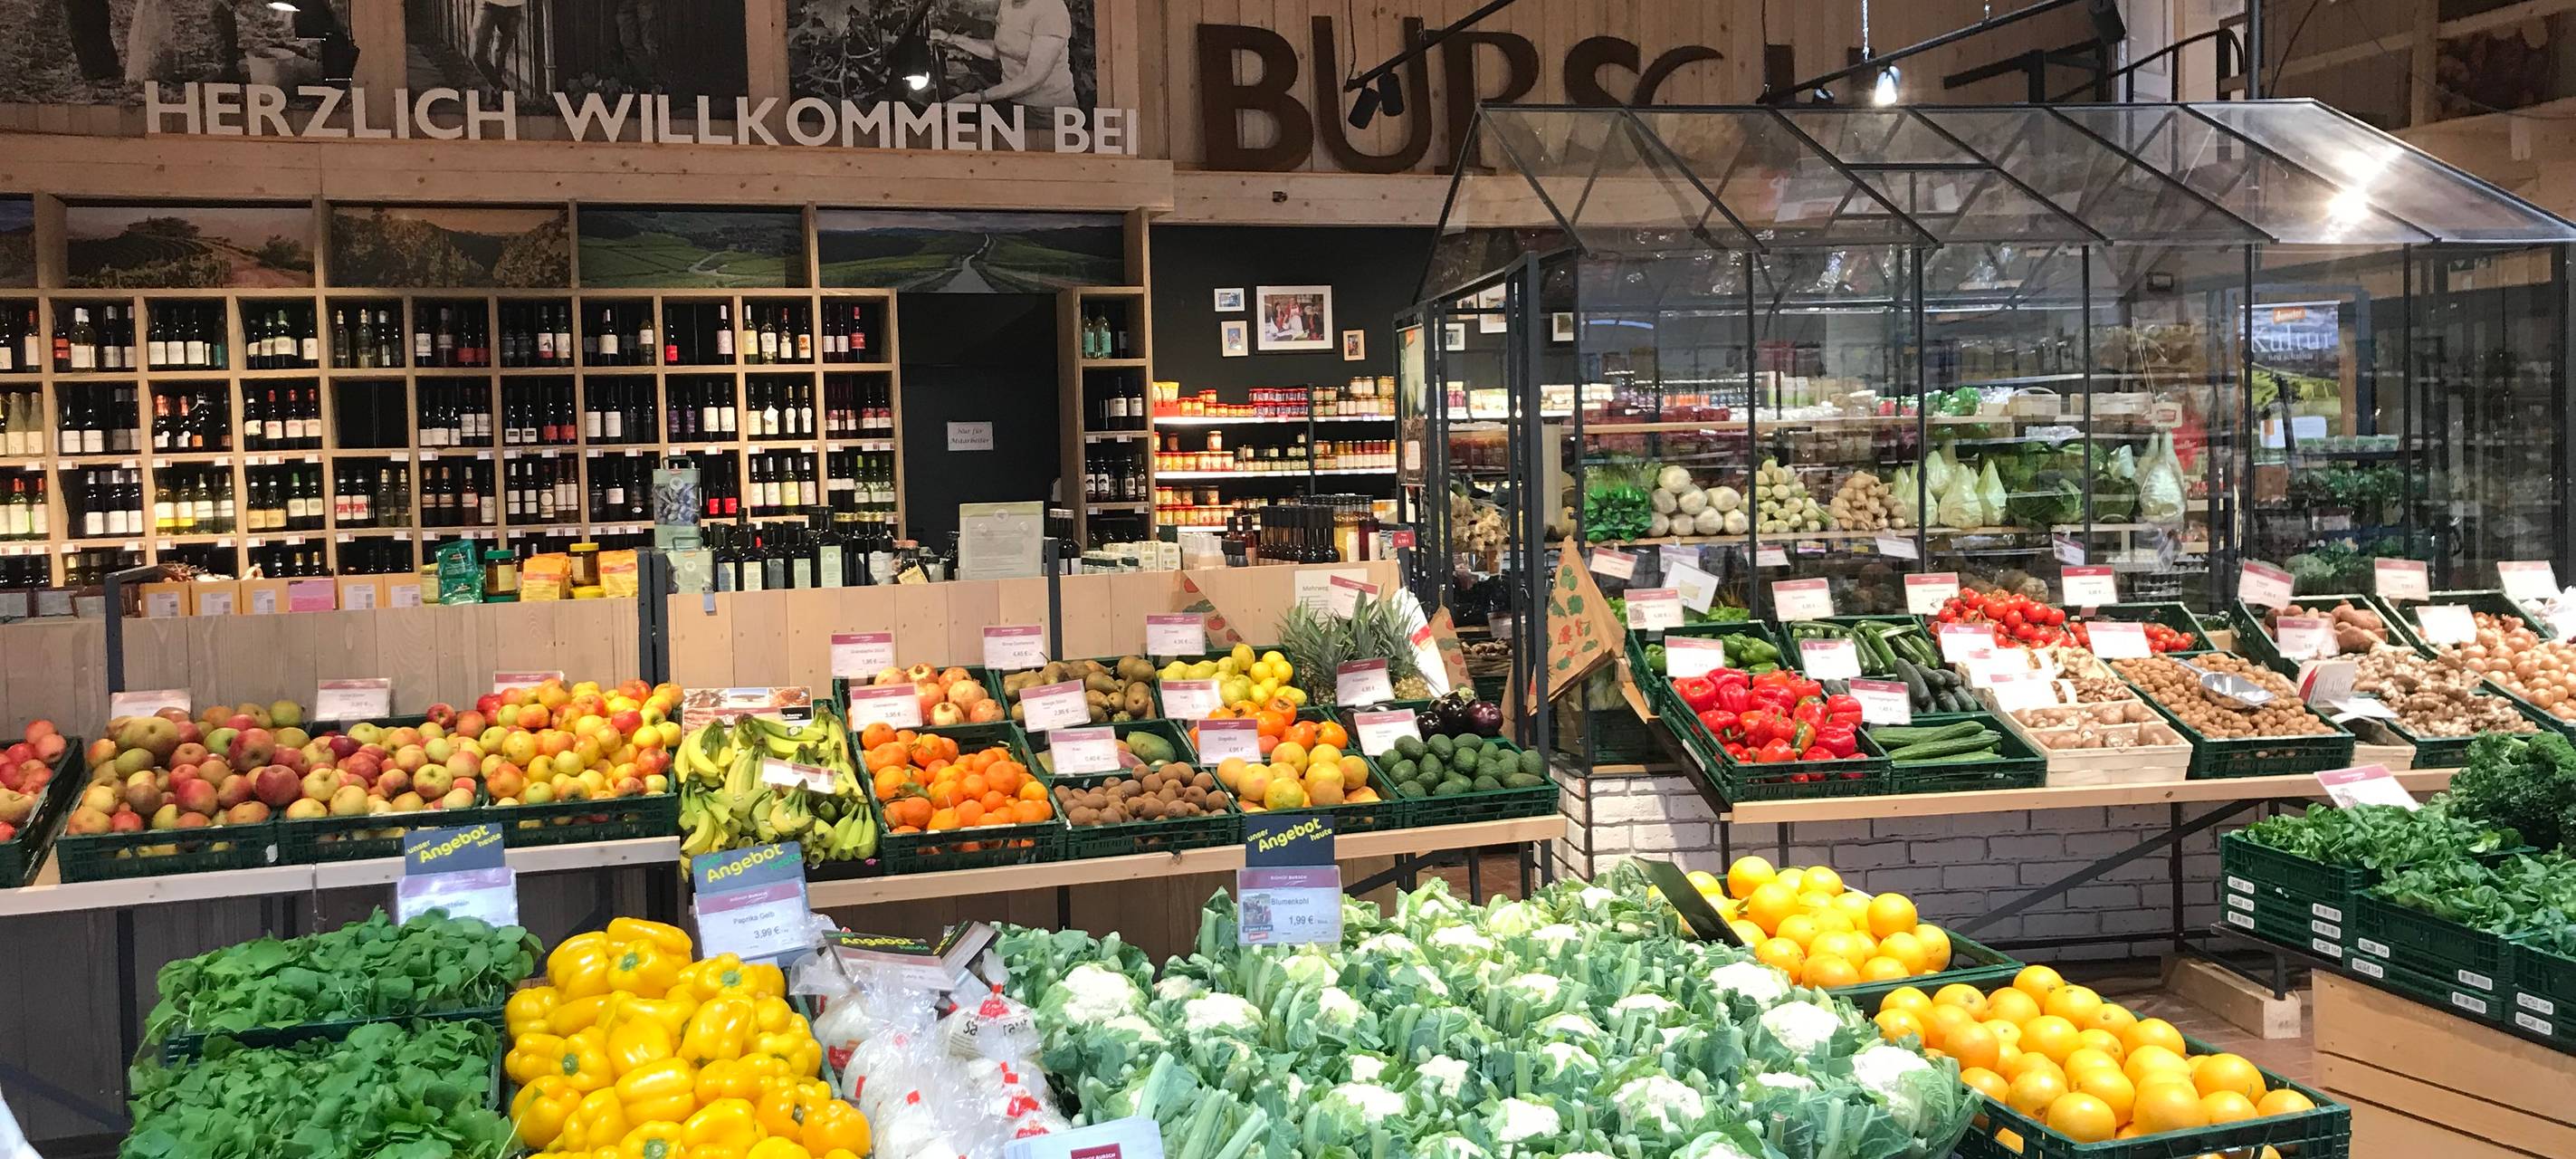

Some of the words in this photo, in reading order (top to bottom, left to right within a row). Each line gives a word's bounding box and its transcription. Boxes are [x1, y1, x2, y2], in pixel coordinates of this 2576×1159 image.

[145, 81, 517, 140] HERZLICH
[553, 92, 1025, 152] WILLKOMMEN
[1054, 106, 1137, 156] BEI
[477, 832, 501, 848] heute
[1247, 829, 1269, 842] unser
[1258, 818, 1322, 853] Angebot
[1310, 828, 1333, 841] heute
[407, 839, 431, 854] unser
[420, 825, 490, 864] Angebot
[707, 844, 785, 883] Angebot
[1271, 897, 1310, 905] Blumenkohl
[733, 915, 758, 924] Paprika
[759, 912, 776, 920] Gelb
[1289, 915, 1305, 926] 1,99
[1308, 915, 1314, 924] €
[754, 927, 772, 939] 3,99
[774, 925, 780, 935] €
[841, 936, 916, 946] Angebot
